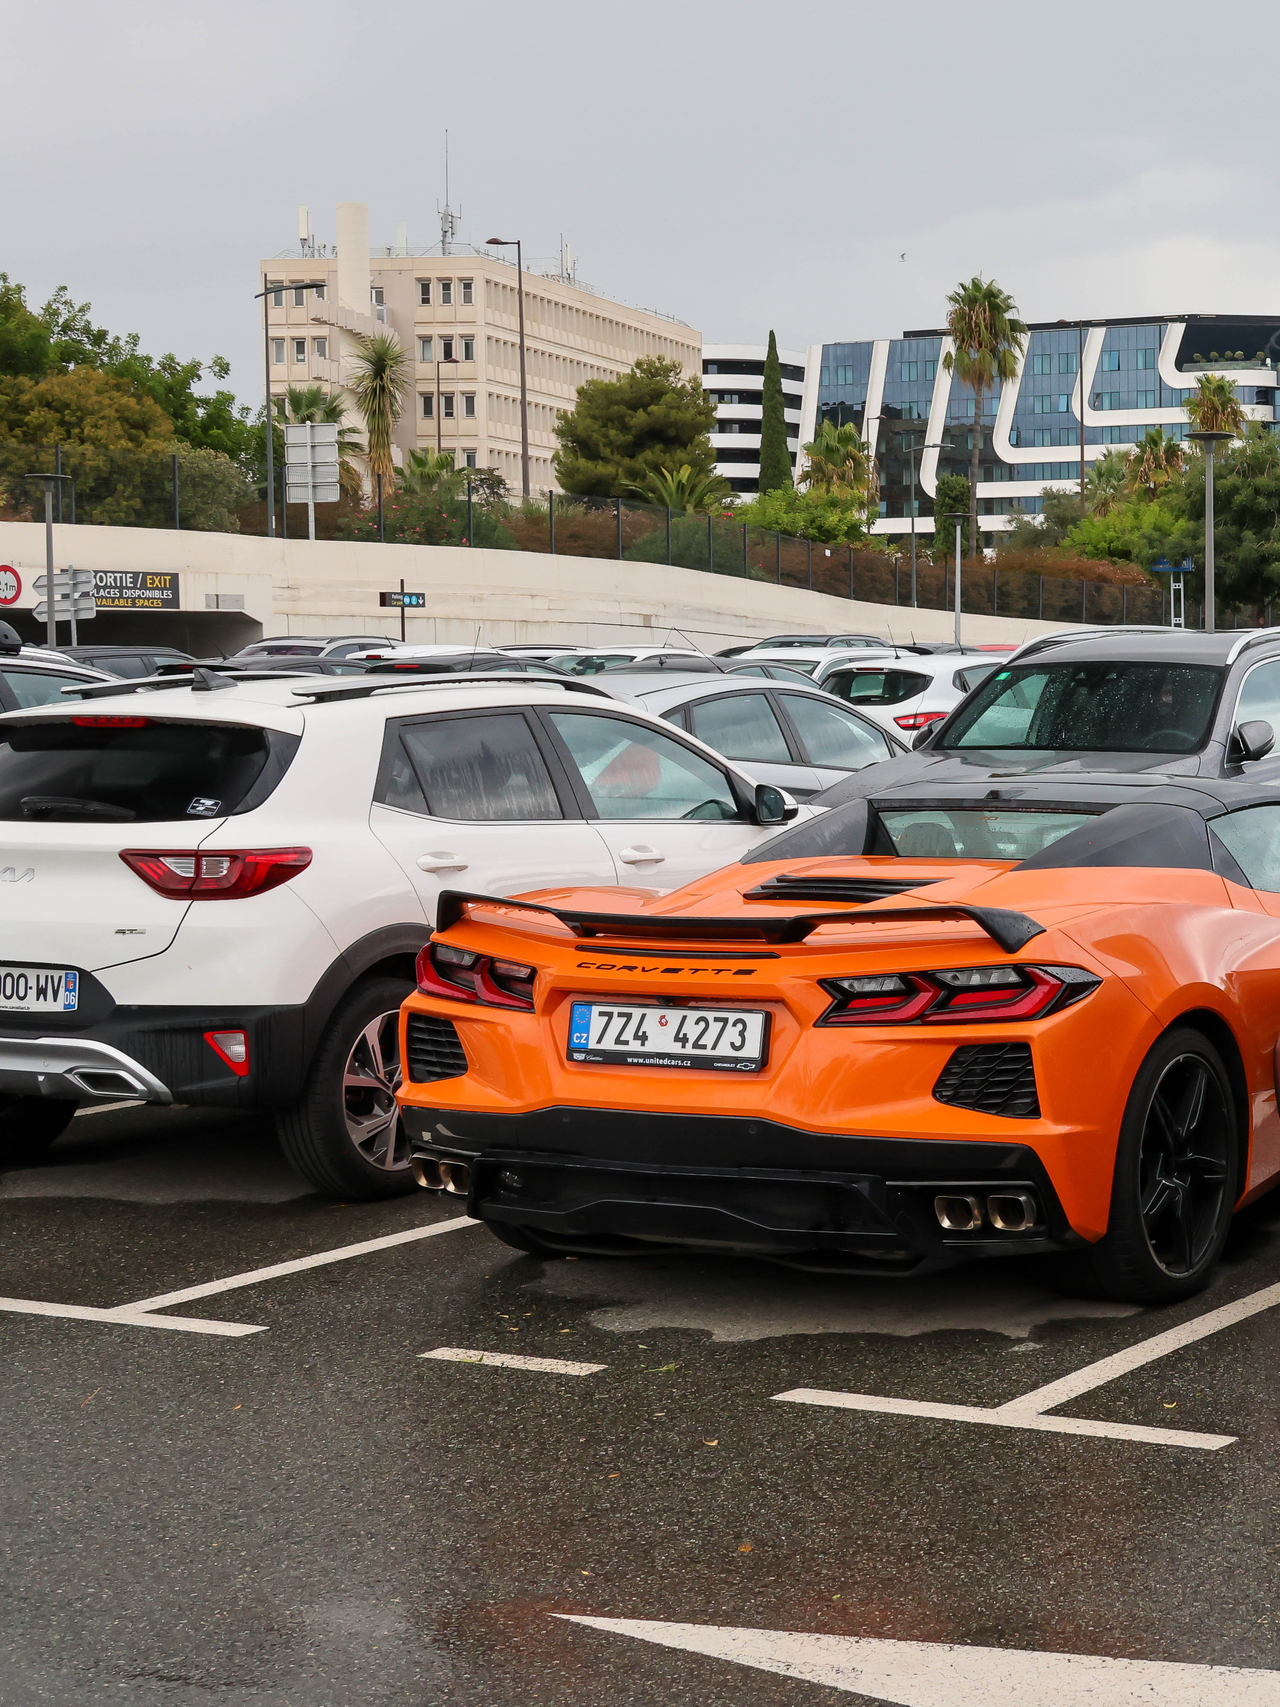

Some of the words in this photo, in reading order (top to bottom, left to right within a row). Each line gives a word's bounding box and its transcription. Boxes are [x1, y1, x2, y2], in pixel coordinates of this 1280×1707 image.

[0, 580, 17, 593] ,1m
[146, 575, 172, 588] EXIT
[89, 588, 120, 598] PLACES
[122, 589, 173, 599] DISPONIBLES
[95, 598, 133, 607] VAILABLE
[135, 599, 162, 608] SPACES
[576, 962, 758, 976] CORVETTE
[0, 972, 63, 1003] 00-WV
[64, 991, 76, 1005] 06
[595, 1011, 649, 1047] 7Z4
[673, 1014, 748, 1052] 4273
[573, 1033, 588, 1044] CZ
[626, 1056, 692, 1067] www.unitedcars.cz
